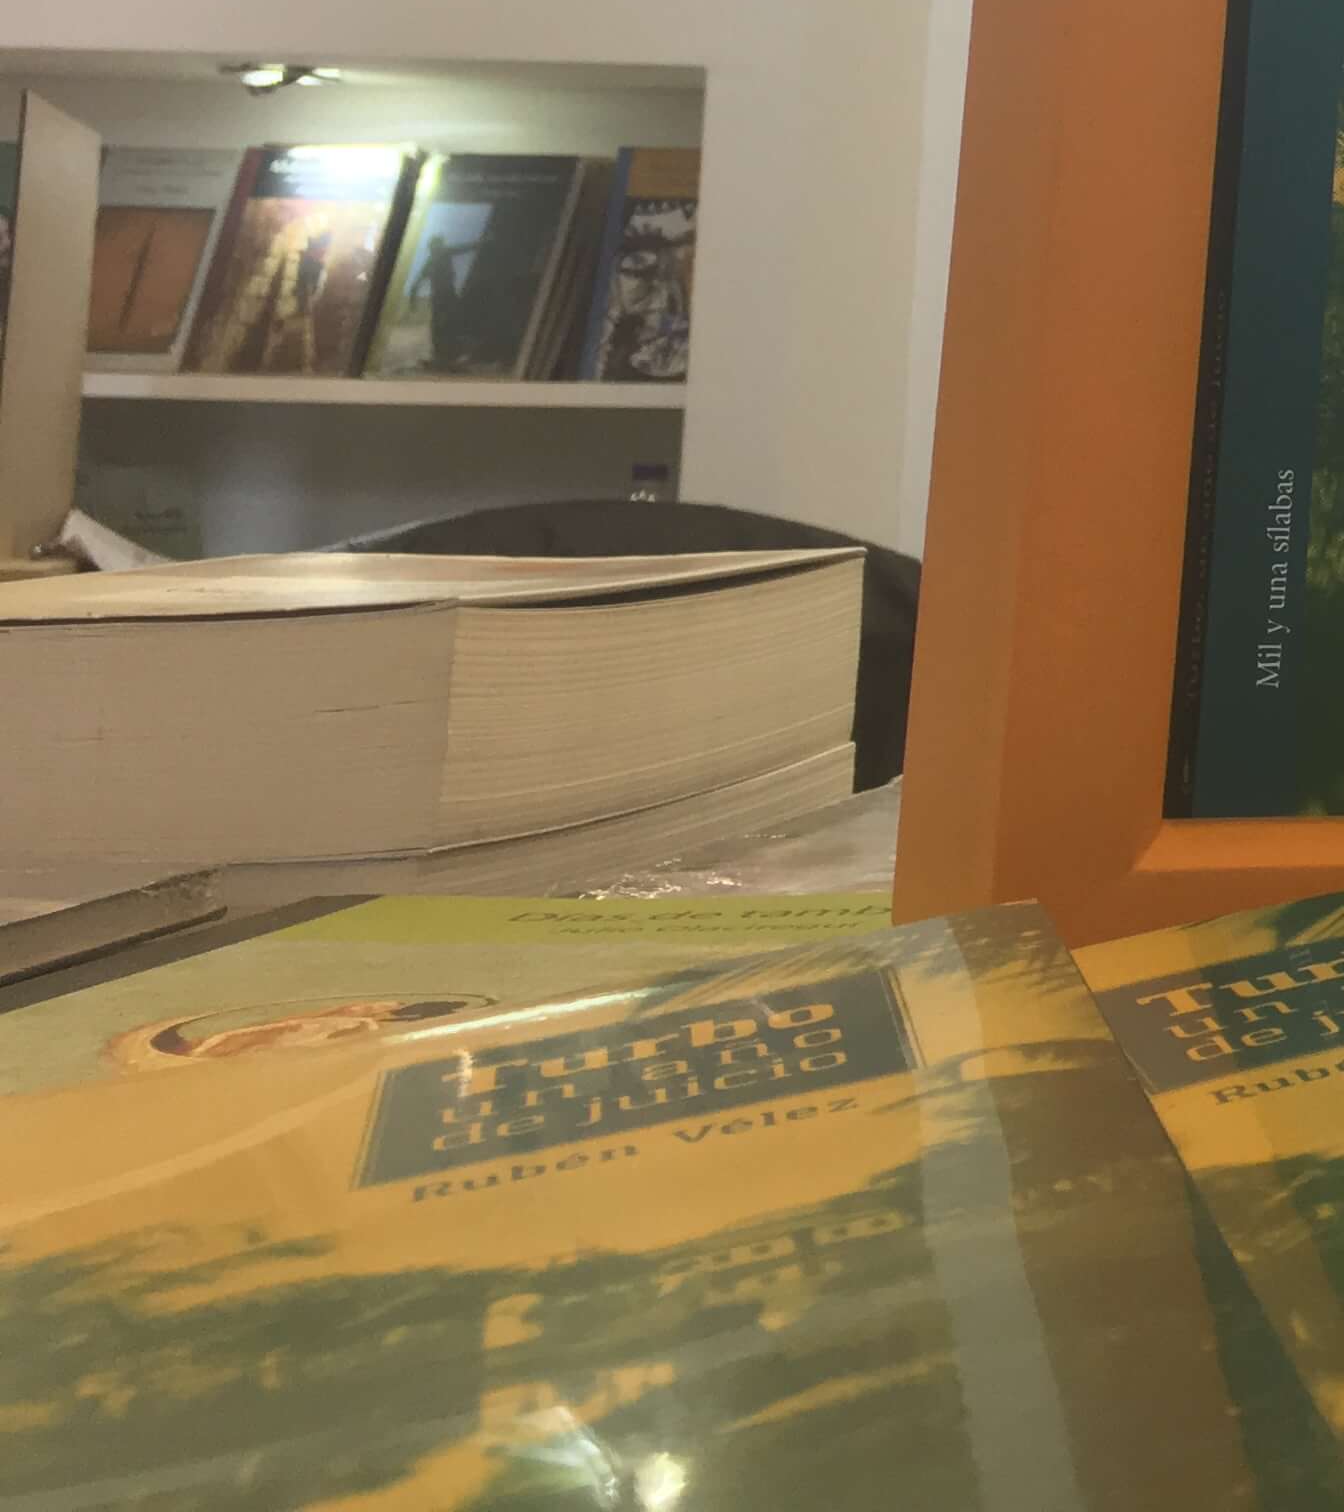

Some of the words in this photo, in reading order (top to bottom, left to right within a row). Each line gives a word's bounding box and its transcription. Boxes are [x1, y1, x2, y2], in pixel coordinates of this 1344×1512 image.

[1265, 468, 1296, 554] sílabas
[1267, 560, 1289, 610] una
[1266, 619, 1291, 635] y
[1255, 642, 1283, 689] Mil
[1164, 999, 1300, 1040] un
[1183, 1024, 1289, 1063] de
[441, 1003, 836, 1099] Turbo
[431, 1110, 546, 1153] de
[574, 1050, 849, 1128] juicio
[441, 1081, 577, 1125] un
[412, 1144, 640, 1202] Rubén
[672, 1095, 861, 1146] Vélez
